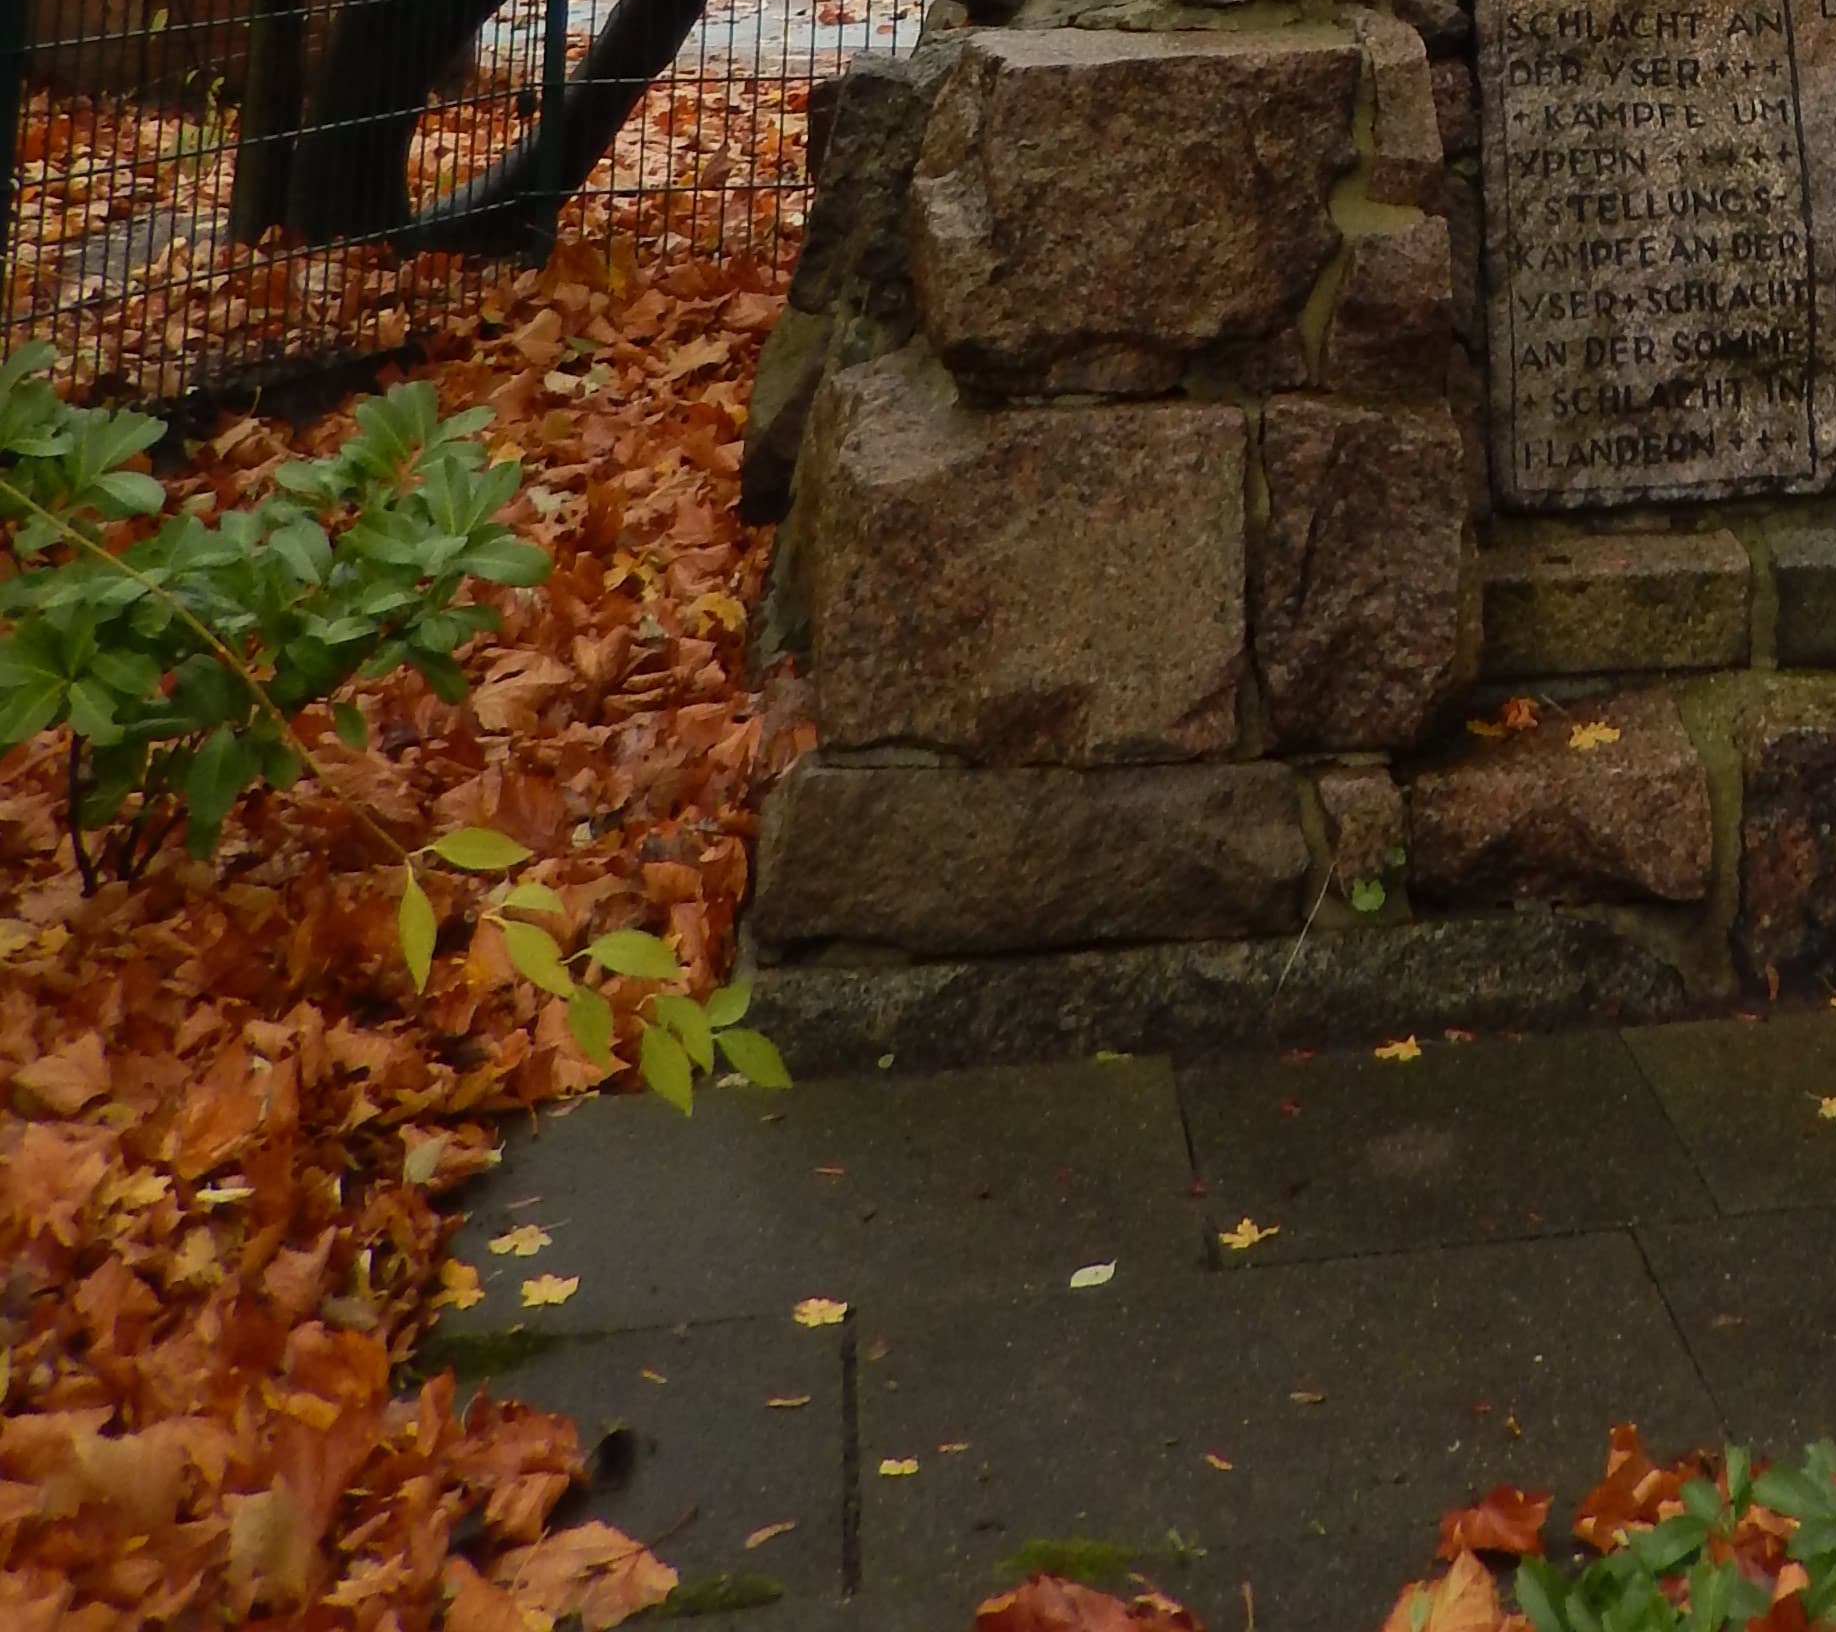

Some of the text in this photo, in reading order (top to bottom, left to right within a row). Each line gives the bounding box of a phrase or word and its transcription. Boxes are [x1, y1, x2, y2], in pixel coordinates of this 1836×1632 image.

[1506, 10, 1783, 41] SCHLACHT AN
[1509, 57, 1701, 88] DER YSER
[1733, 98, 1789, 126] UM
[1514, 147, 1648, 179] YPERN
[1668, 235, 1718, 263] AN
[1731, 230, 1798, 261] DER
[1519, 329, 1803, 371] AN DER SOMME
[1551, 374, 1806, 418] SCHLACHT IN
[1524, 430, 1716, 469] FLANDERN
